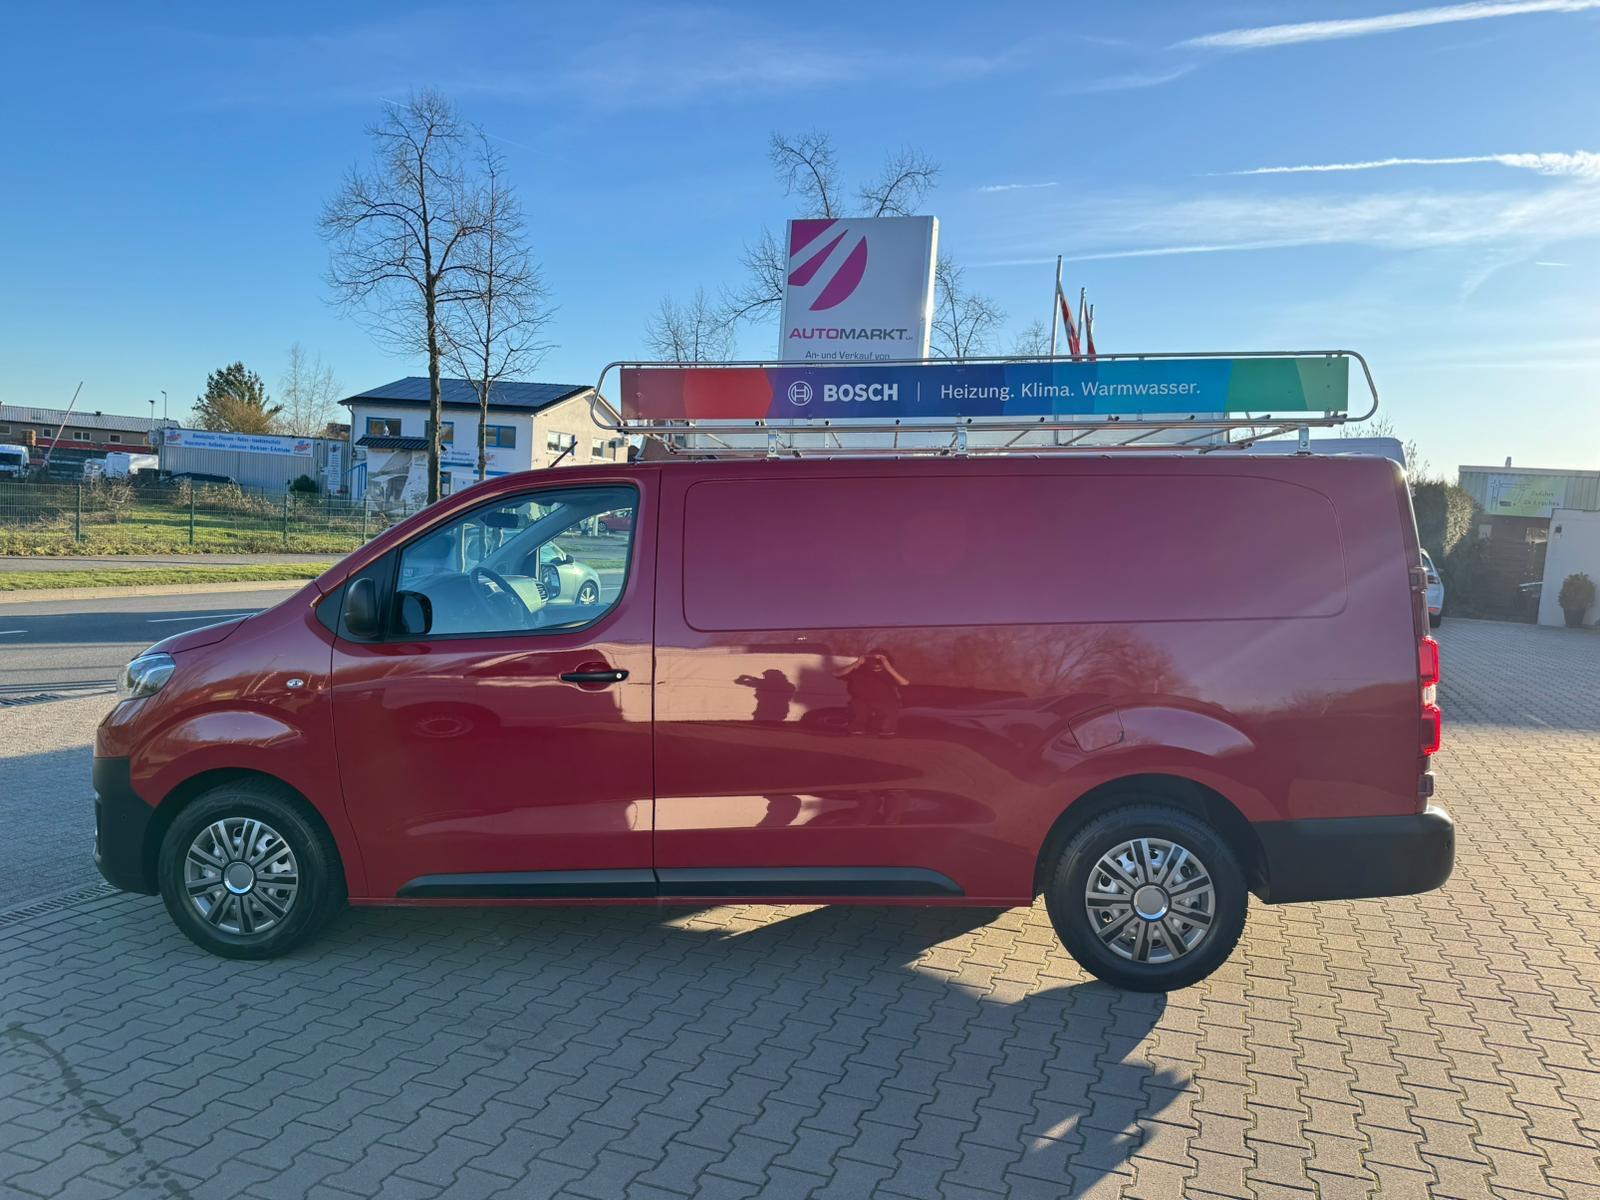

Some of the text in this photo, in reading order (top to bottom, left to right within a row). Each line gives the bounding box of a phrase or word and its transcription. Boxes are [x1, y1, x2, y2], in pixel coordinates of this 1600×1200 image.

[789, 327, 907, 340] AUTOMARKT
[805, 350, 819, 359] An-
[821, 350, 837, 359] und
[839, 351, 873, 360] Verkauf
[823, 381, 1200, 402] BOSCH Heizung. Klima. Warmwasser.
